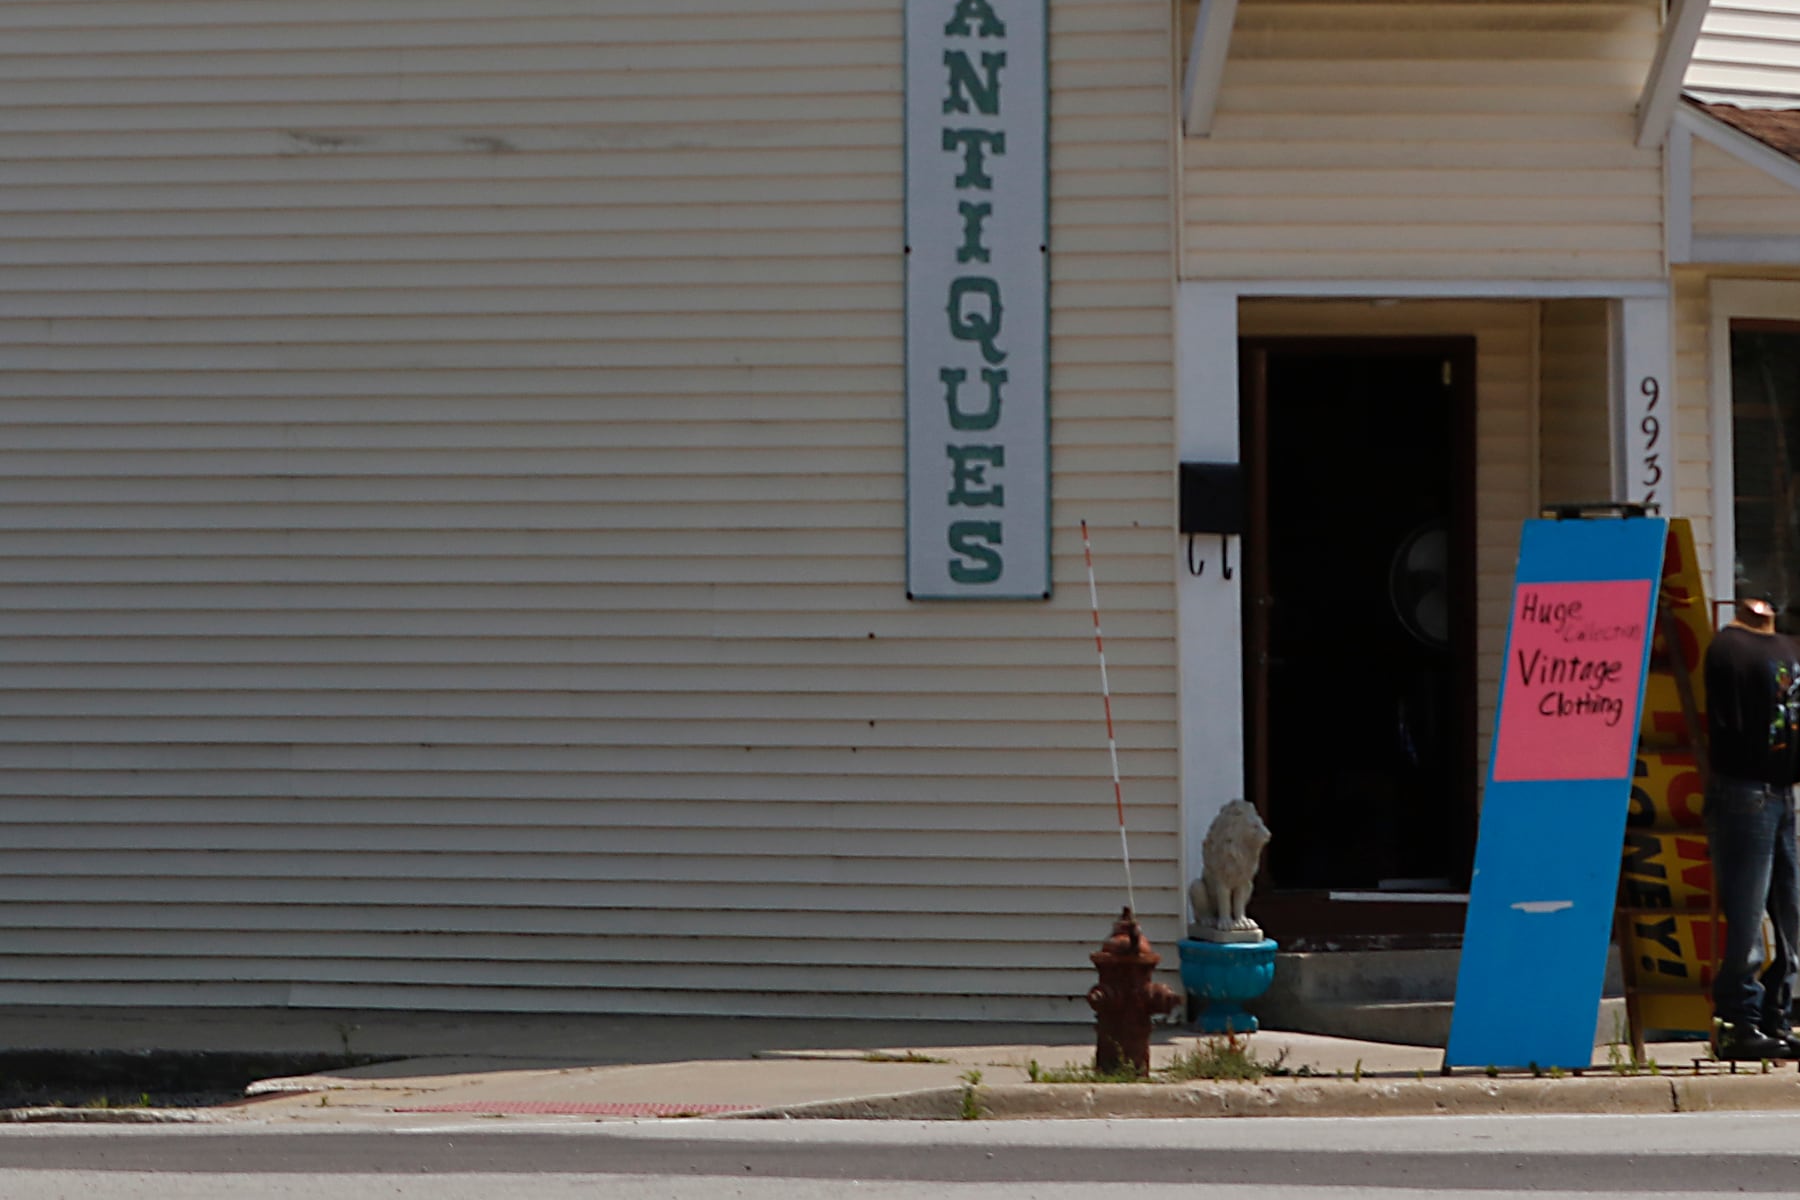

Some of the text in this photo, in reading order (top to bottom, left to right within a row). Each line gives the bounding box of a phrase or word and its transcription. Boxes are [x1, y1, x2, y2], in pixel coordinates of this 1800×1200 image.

[1521, 591, 1583, 634] Huge
[1517, 647, 1623, 692] Vintage
[1538, 690, 1624, 728] Clothing
